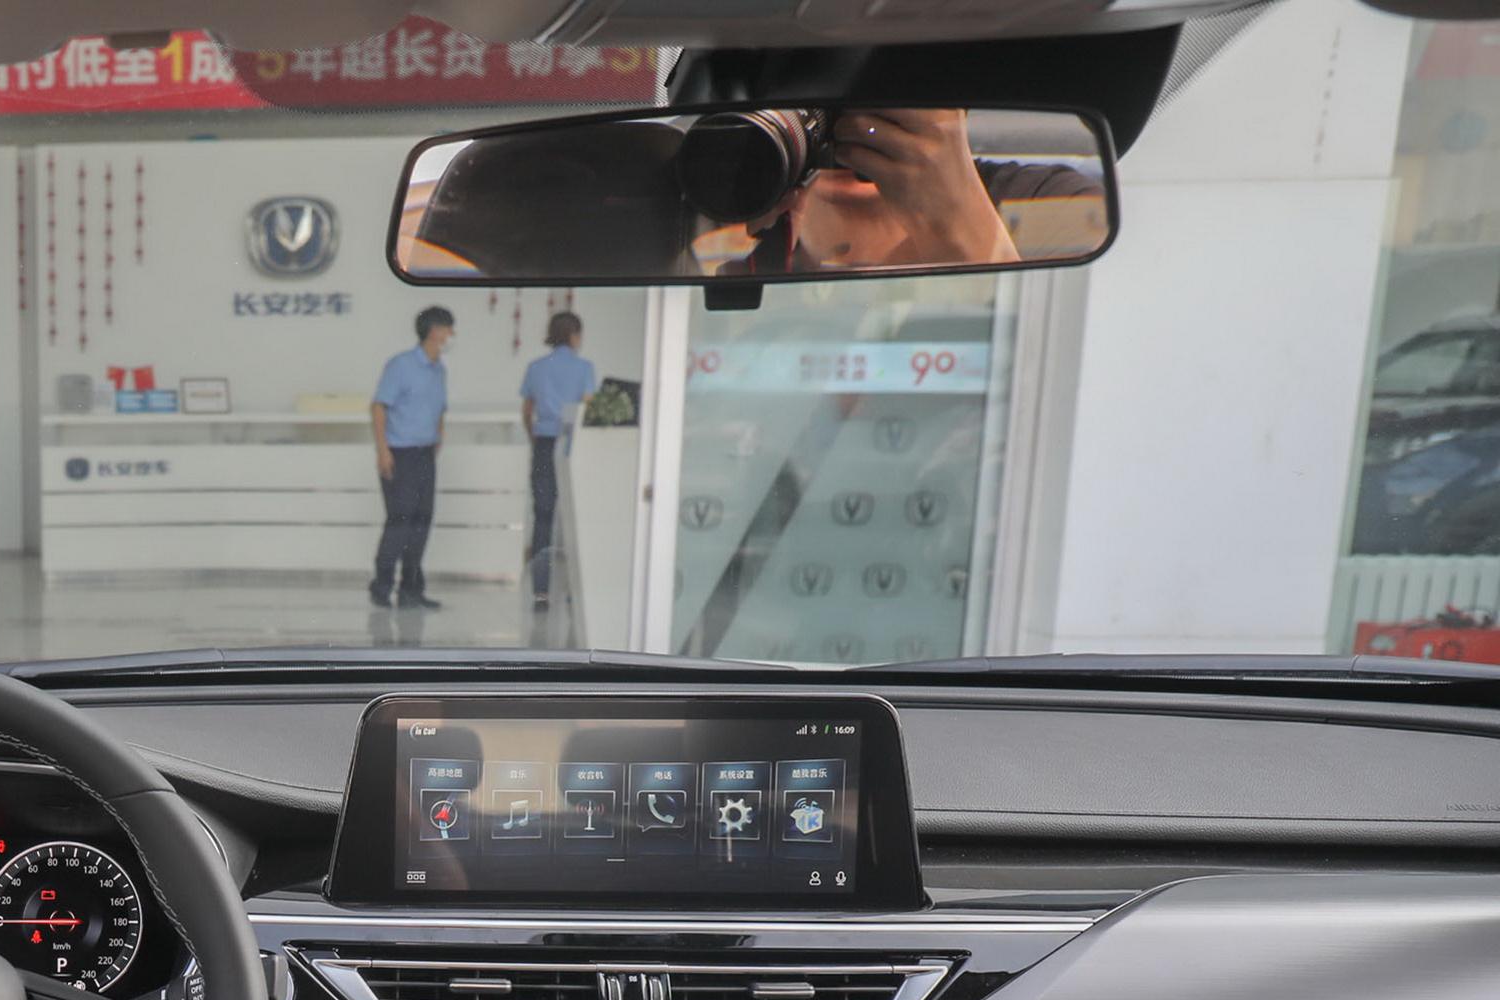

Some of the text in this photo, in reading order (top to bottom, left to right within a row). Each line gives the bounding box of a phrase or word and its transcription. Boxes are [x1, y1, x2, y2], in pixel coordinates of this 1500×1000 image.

[233, 292, 352, 316] 长安汽车
[98, 460, 169, 475] 长安汽车
[834, 726, 855, 735] 16:09
[510, 769, 527, 779] 音乐
[577, 770, 604, 780] 收音机
[654, 770, 673, 781] 电话
[718, 769, 755, 780] 系统设置
[47, 859, 58, 867] 80
[65, 859, 80, 867] 100
[28, 865, 38, 873] 60
[84, 866, 98, 874] 120
[11, 878, 21, 887] 40
[100, 879, 114, 888] 140
[1, 896, 12, 905] 20
[110, 898, 125, 906] 160
[113, 918, 128, 926] 180
[52, 942, 71, 950] km/h
[108, 938, 124, 947] 200
[56, 957, 68, 973] P
[98, 957, 113, 965] 220
[81, 970, 97, 979] 240
